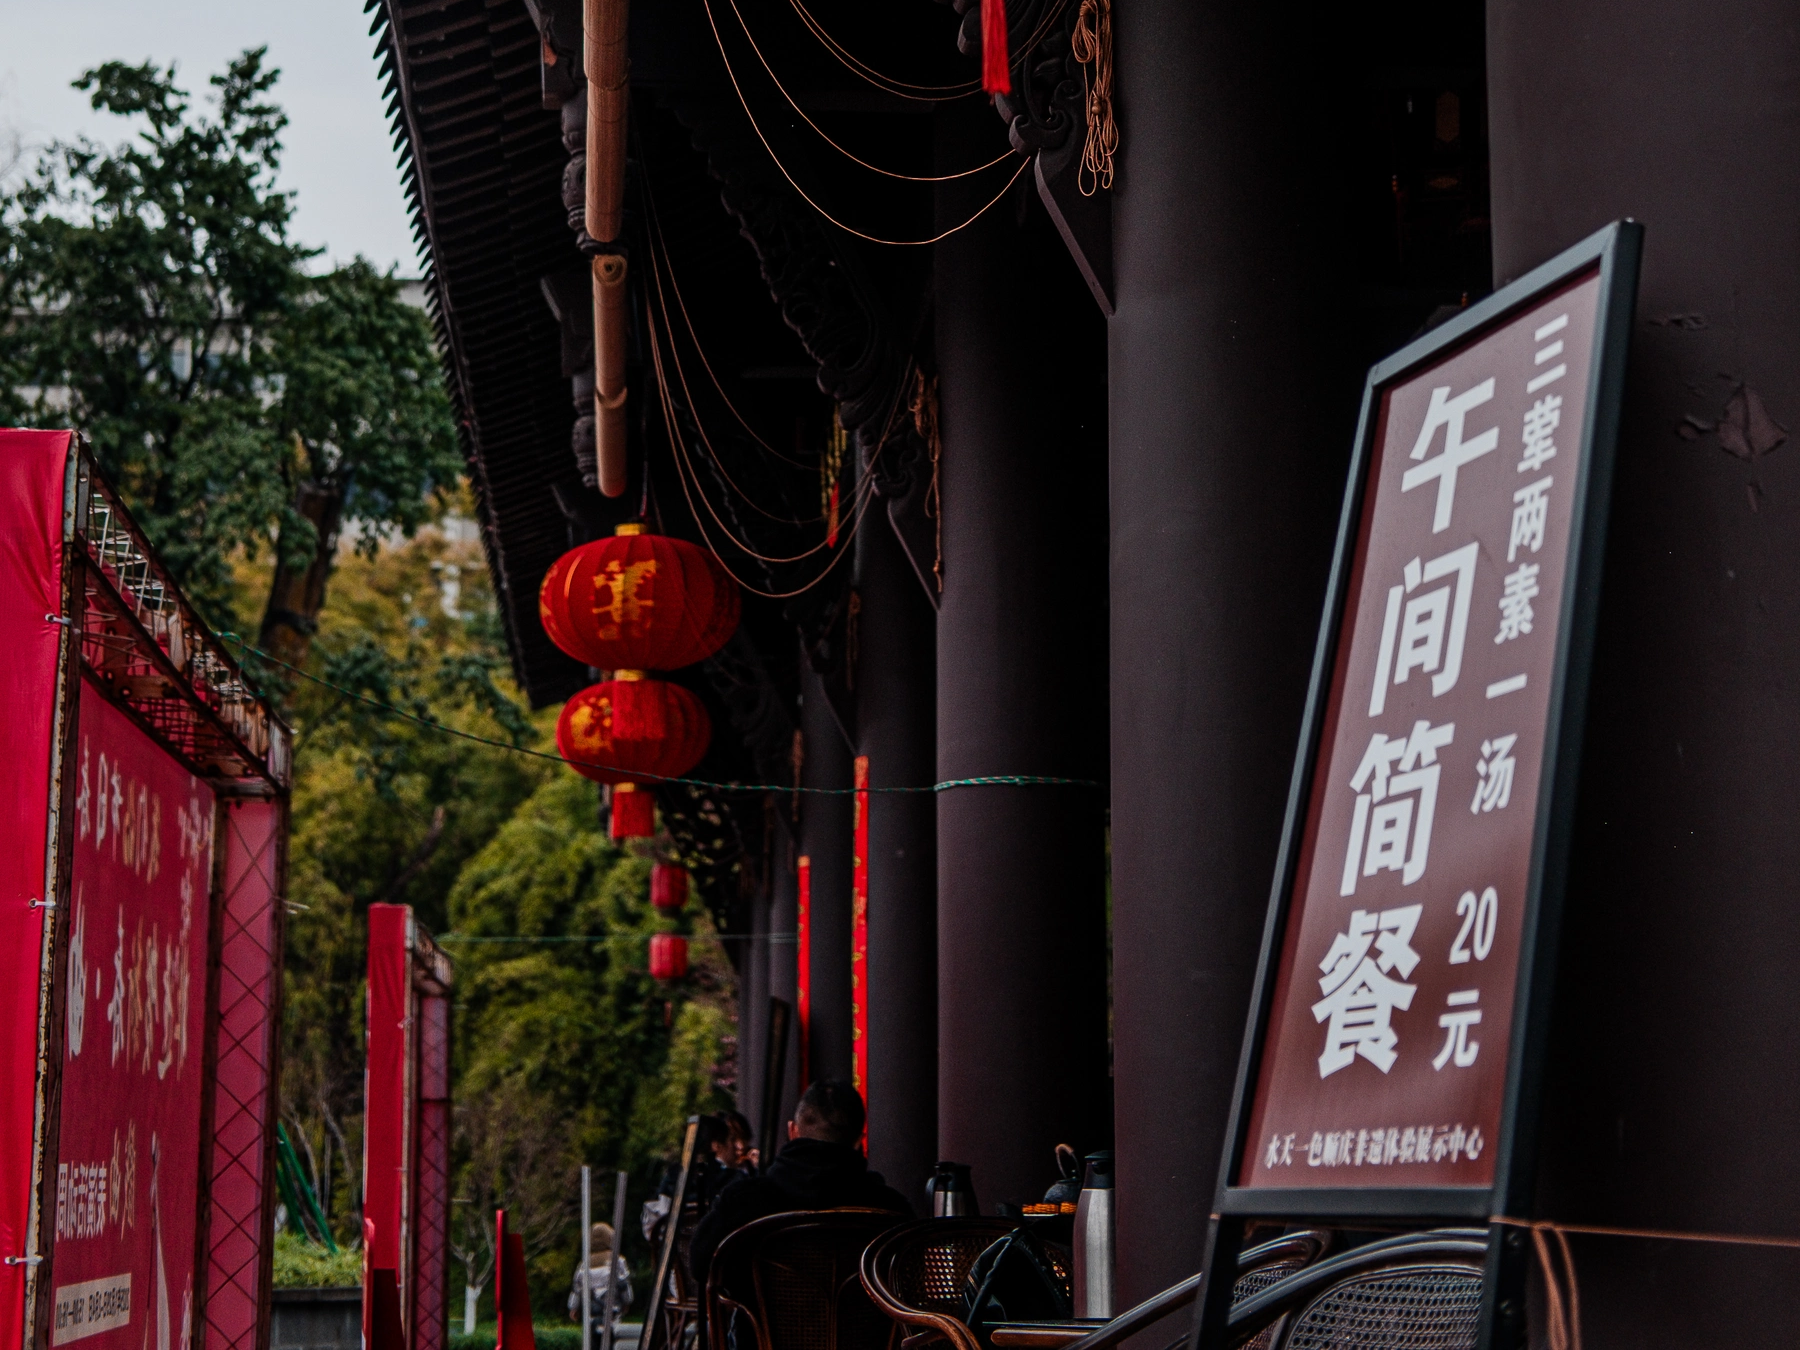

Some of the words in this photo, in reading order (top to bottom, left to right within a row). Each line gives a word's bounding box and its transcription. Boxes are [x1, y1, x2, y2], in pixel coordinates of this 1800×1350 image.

[1311, 377, 1500, 1079] 午间简餐
[1470, 313, 1569, 815] 三荤两素一汤
